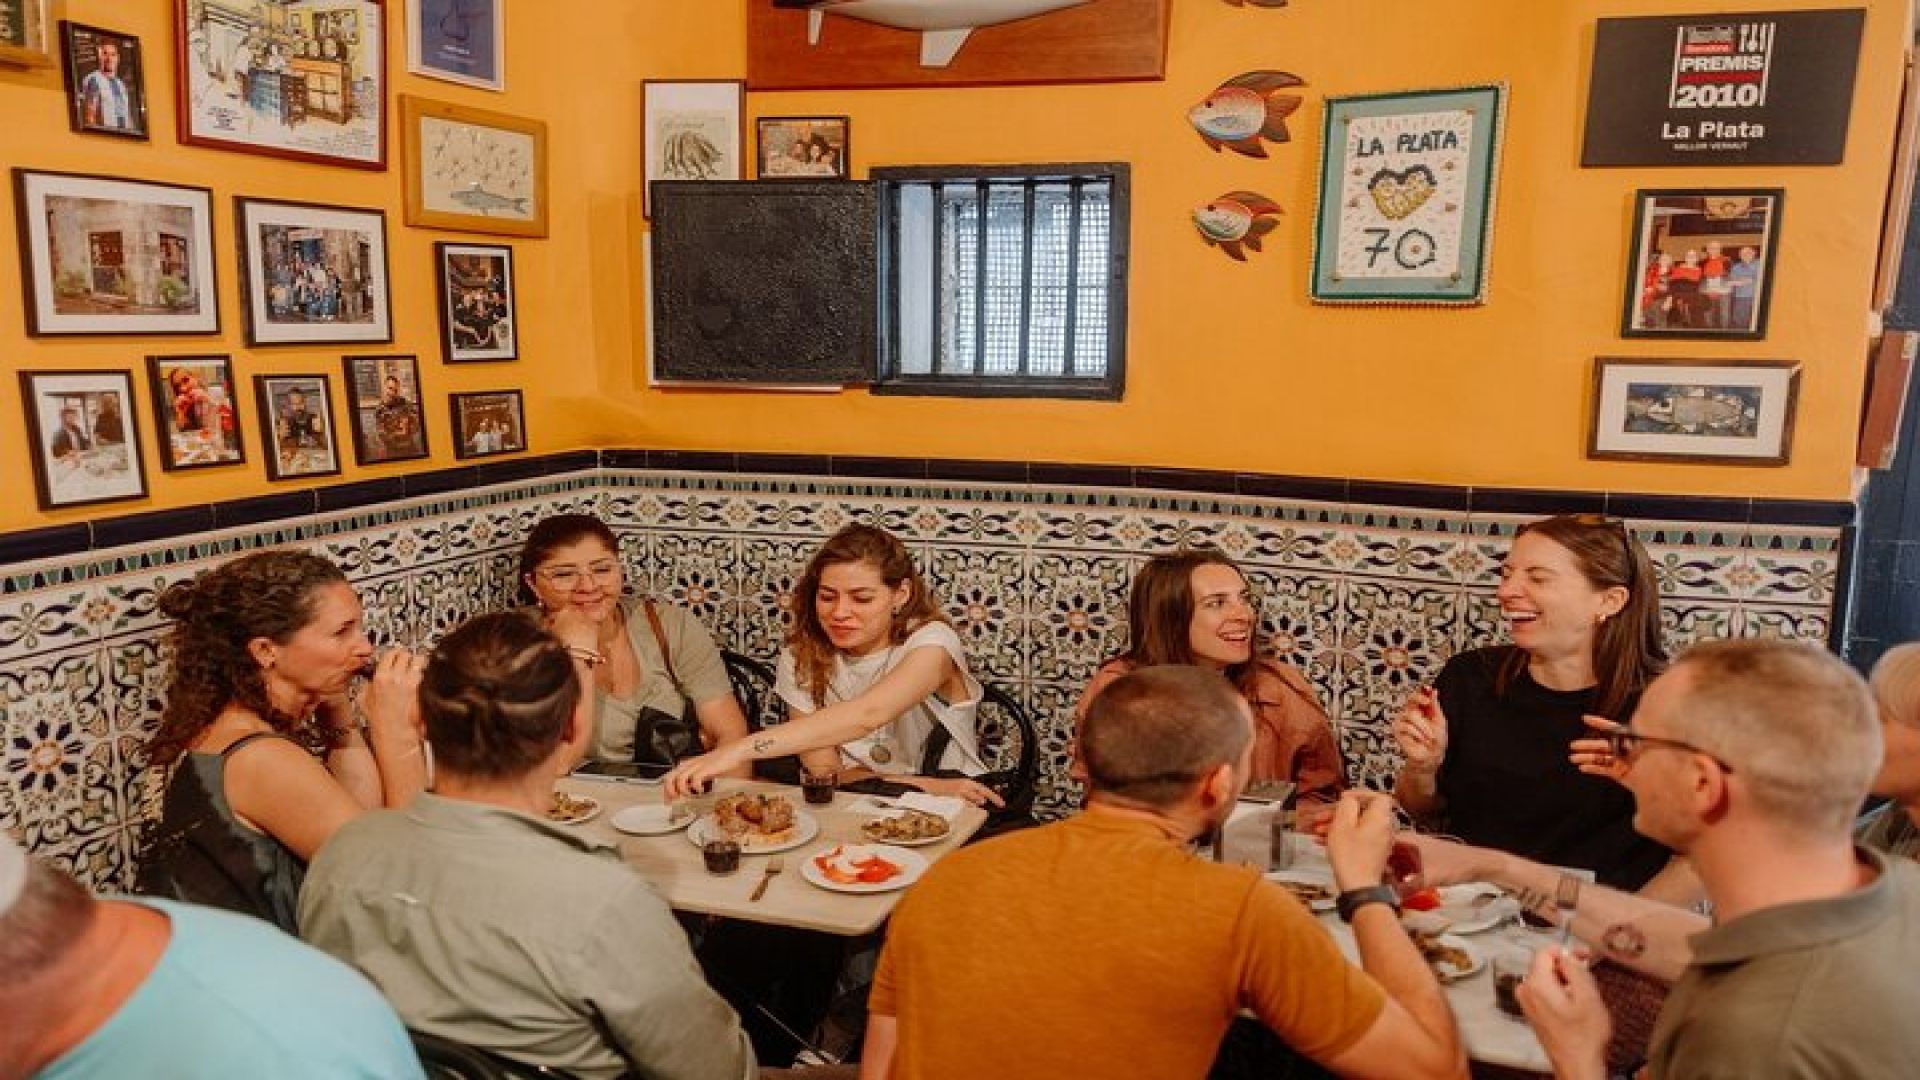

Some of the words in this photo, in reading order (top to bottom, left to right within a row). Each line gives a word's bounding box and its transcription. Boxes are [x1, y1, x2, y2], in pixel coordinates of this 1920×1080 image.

[1679, 55, 1764, 72] PREMIS
[1676, 84, 1759, 107] 2010
[1662, 121, 1690, 139] La
[1699, 121, 1764, 139] Plata
[1356, 137, 1385, 157] LA
[1397, 130, 1458, 153] PLATA
[1363, 228, 1437, 269] 70
